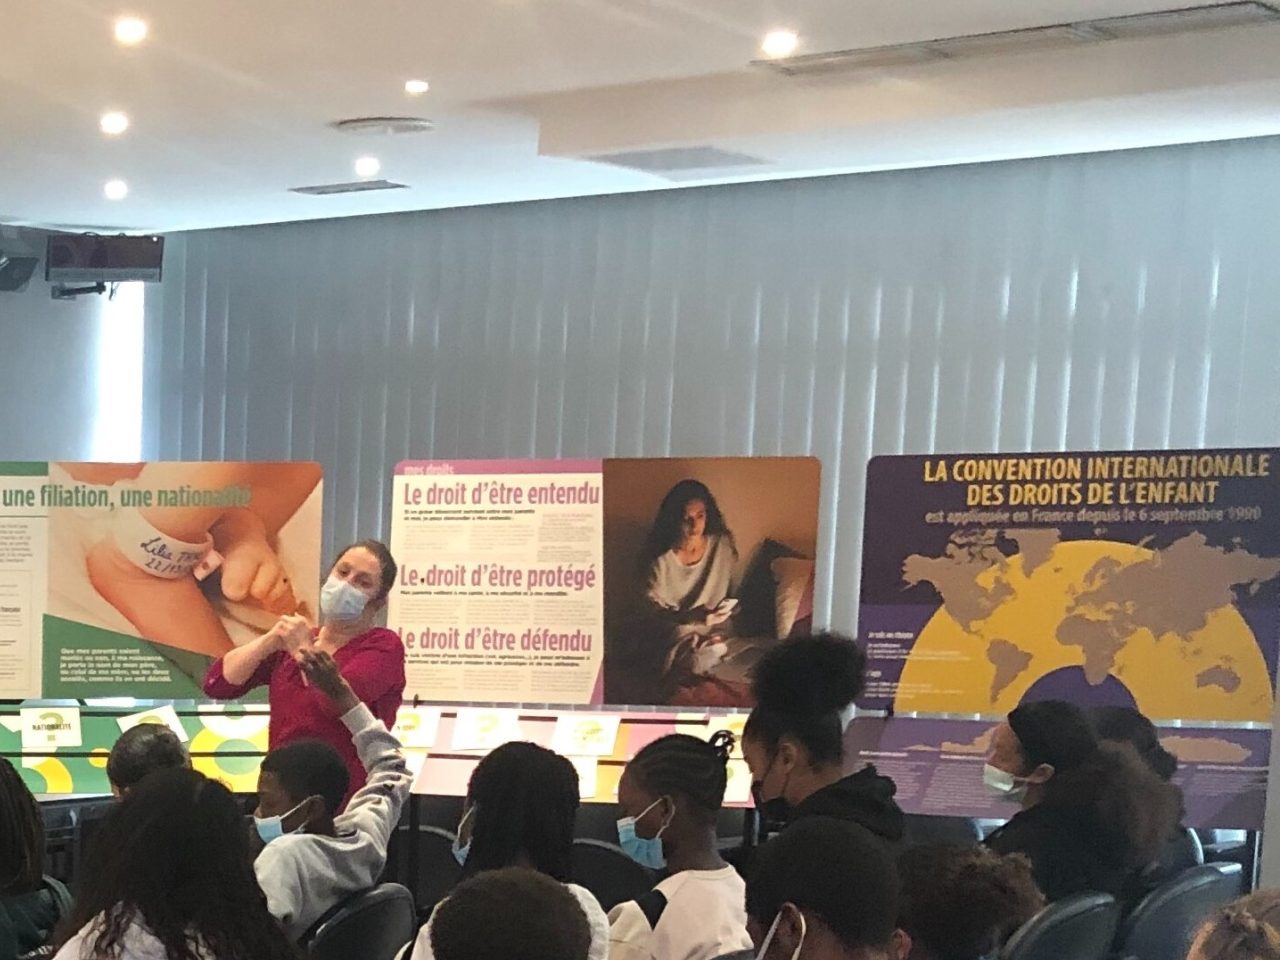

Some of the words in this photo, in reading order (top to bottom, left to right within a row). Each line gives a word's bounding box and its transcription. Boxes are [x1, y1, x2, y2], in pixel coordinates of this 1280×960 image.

[404, 465, 424, 475] mes
[425, 463, 455, 475] droits
[923, 460, 948, 482] LA
[952, 457, 1082, 481] CONVENTION
[1087, 454, 1271, 479] INTERNATIONALE
[2, 489, 35, 507] une
[40, 484, 115, 511] filiation,
[120, 489, 153, 507] une
[404, 483, 422, 505] Le
[427, 482, 466, 505] droit
[471, 481, 523, 505] d'être
[528, 481, 599, 505] entendu
[967, 483, 1005, 506] DES
[1009, 482, 1083, 505] DROITS
[1087, 482, 1114, 505] DE
[1120, 481, 1220, 504] L'ENFANT
[925, 510, 944, 523] est
[946, 508, 1010, 526] appliquée
[1012, 510, 1029, 522] en
[1031, 508, 1074, 522] France
[1077, 507, 1121, 525] depuis
[1123, 507, 1136, 521] le
[1138, 507, 1148, 521] 6
[1150, 507, 1223, 524] septembre
[400, 564, 418, 587] Le
[426, 564, 466, 587] droit
[471, 563, 522, 587] d'être
[527, 563, 596, 590] protégé
[420, 627, 460, 650] droit
[465, 627, 516, 650] d'être
[521, 627, 592, 652] défendu
